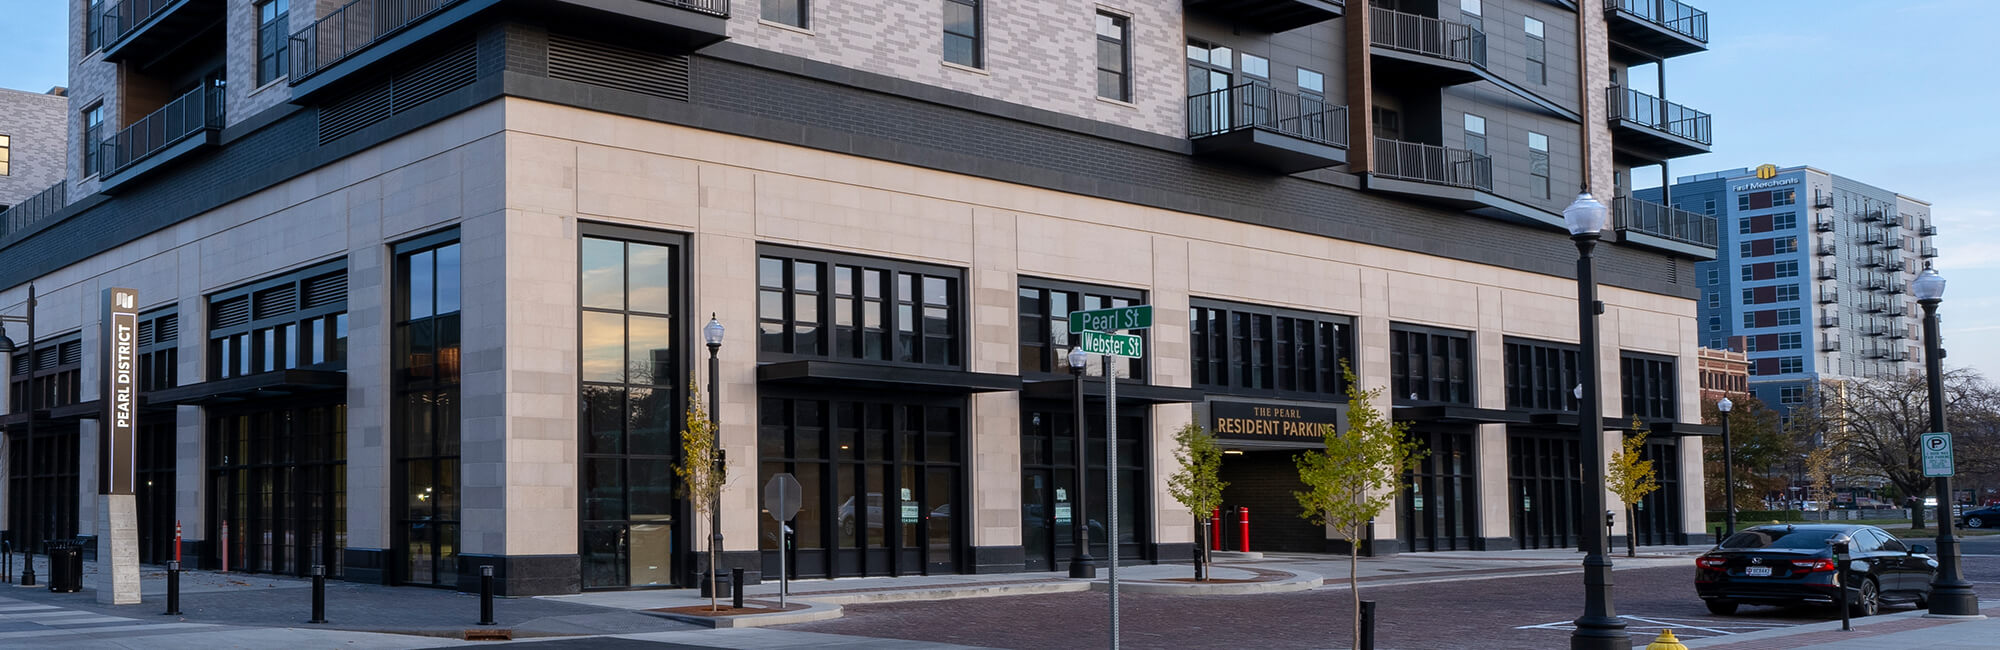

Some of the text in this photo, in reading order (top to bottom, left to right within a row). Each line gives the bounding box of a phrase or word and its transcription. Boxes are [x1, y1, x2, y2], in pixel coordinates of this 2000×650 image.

[1733, 177, 1799, 192] First Merchants
[1082, 308, 1139, 330] Pearl St
[1084, 332, 1140, 357] Webster St
[117, 324, 131, 428] PEARL DISTRICT
[1254, 407, 1301, 418] THE PEARL
[1218, 417, 1280, 435] RESIDENT
[1931, 438, 1943, 449] P
